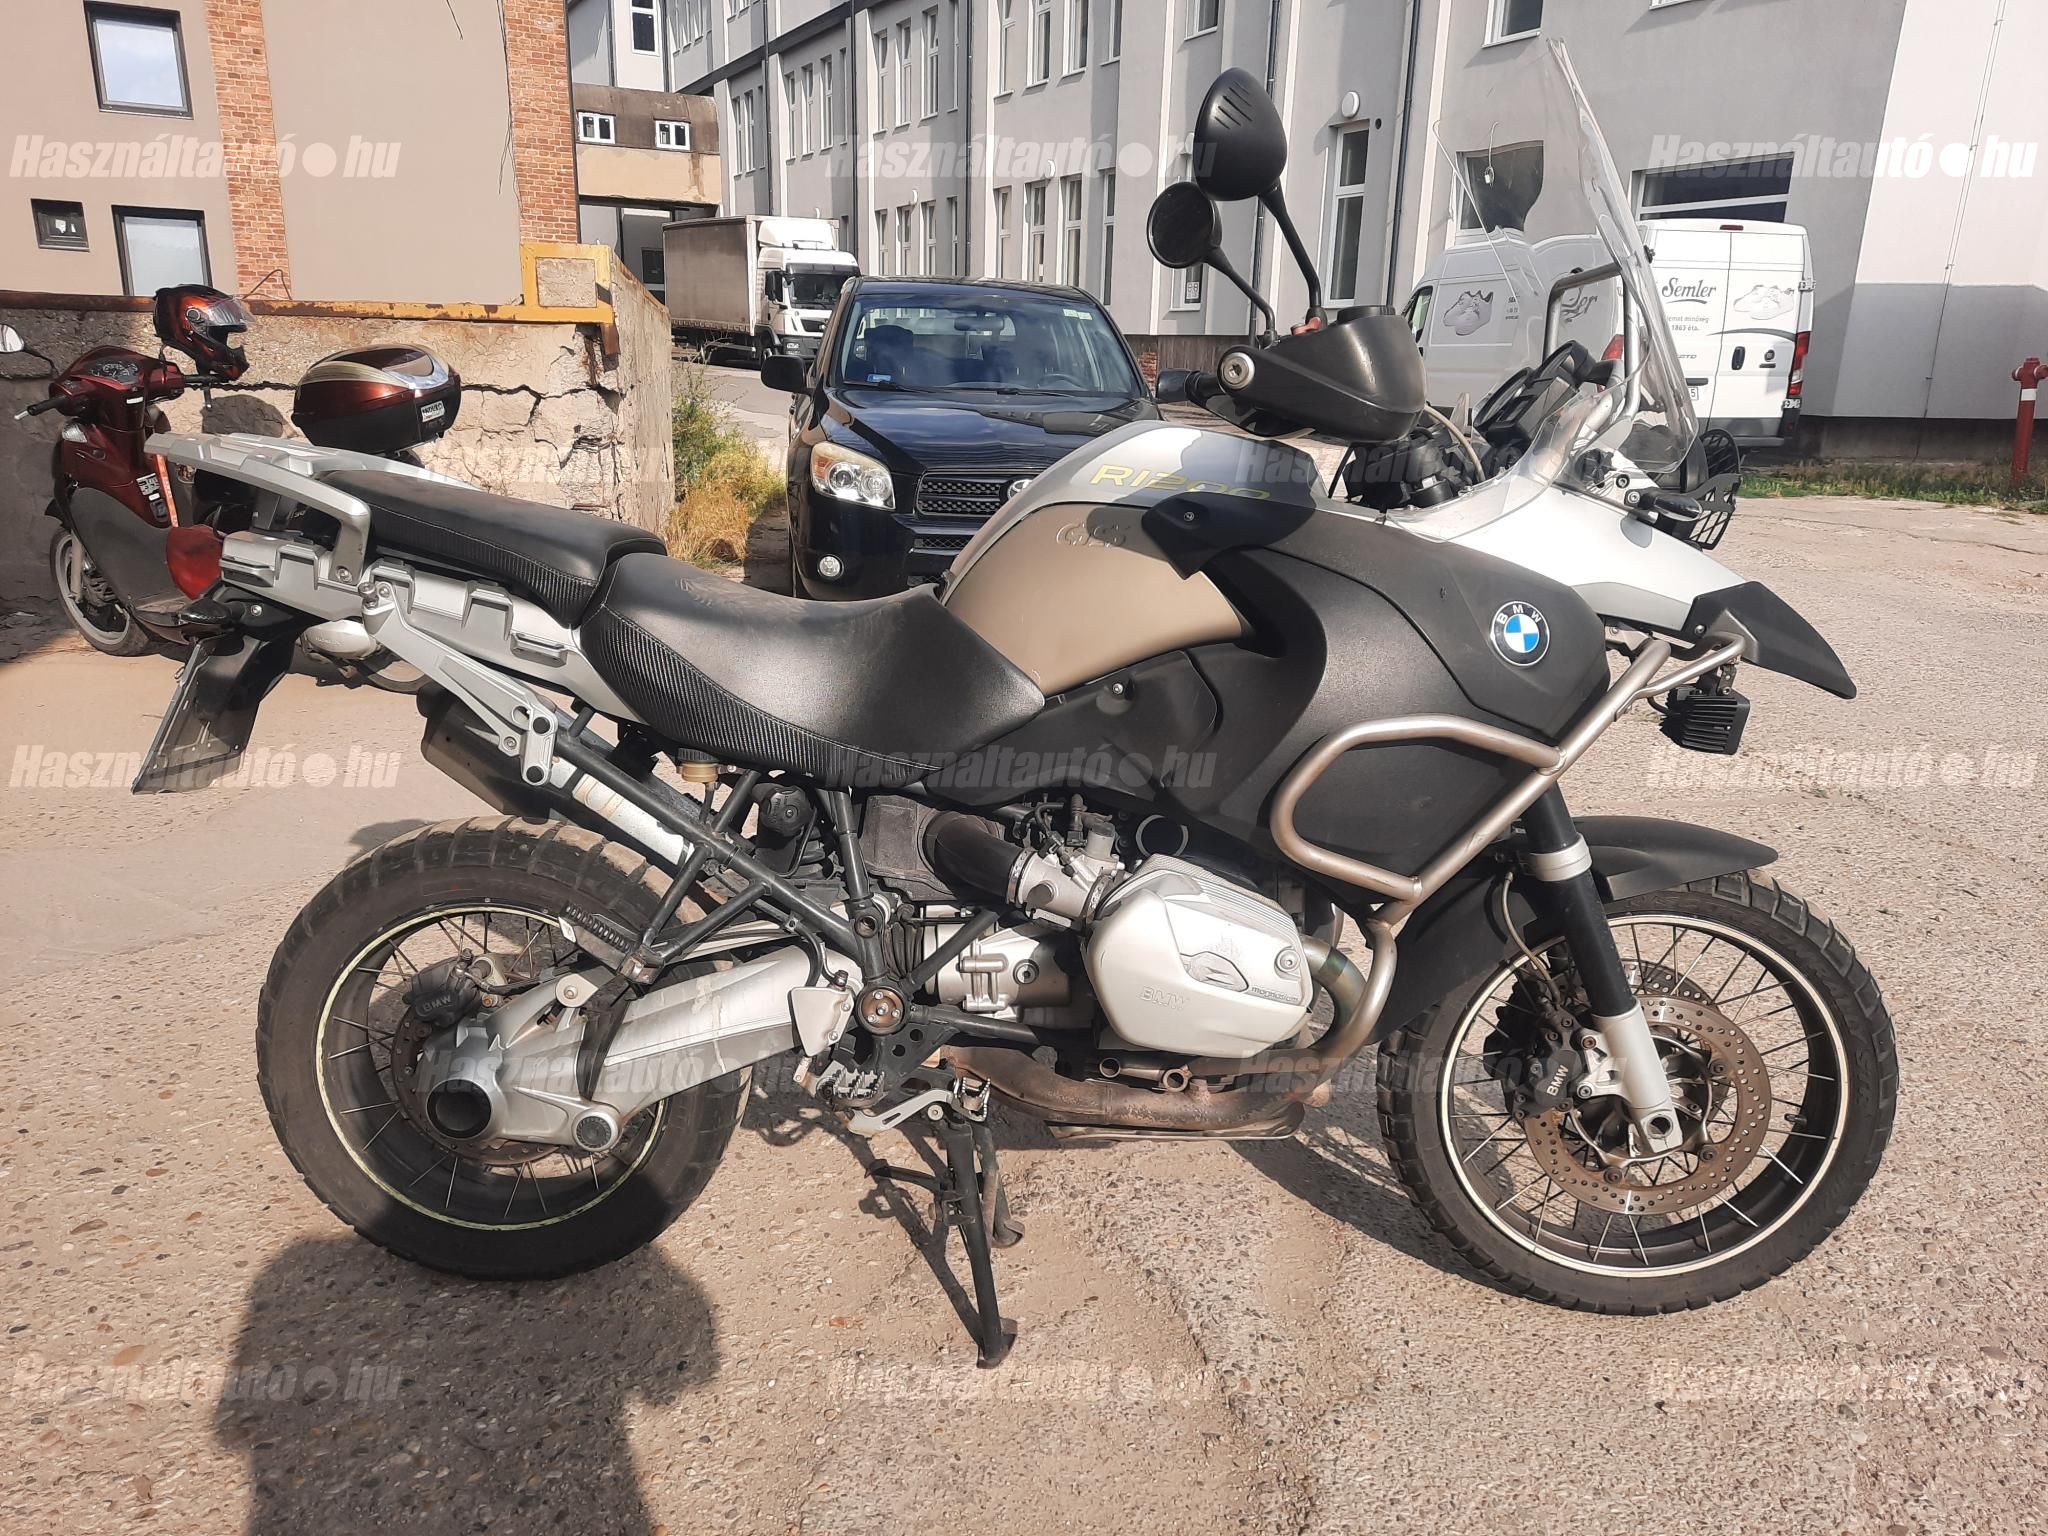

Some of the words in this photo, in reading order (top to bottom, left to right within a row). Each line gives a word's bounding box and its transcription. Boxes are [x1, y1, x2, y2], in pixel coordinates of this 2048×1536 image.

[1661, 277, 1716, 298] Semler
[1496, 604, 1542, 625] BMW
[1138, 986, 1188, 1012] BMW
[1546, 1064, 1569, 1097] BMW
